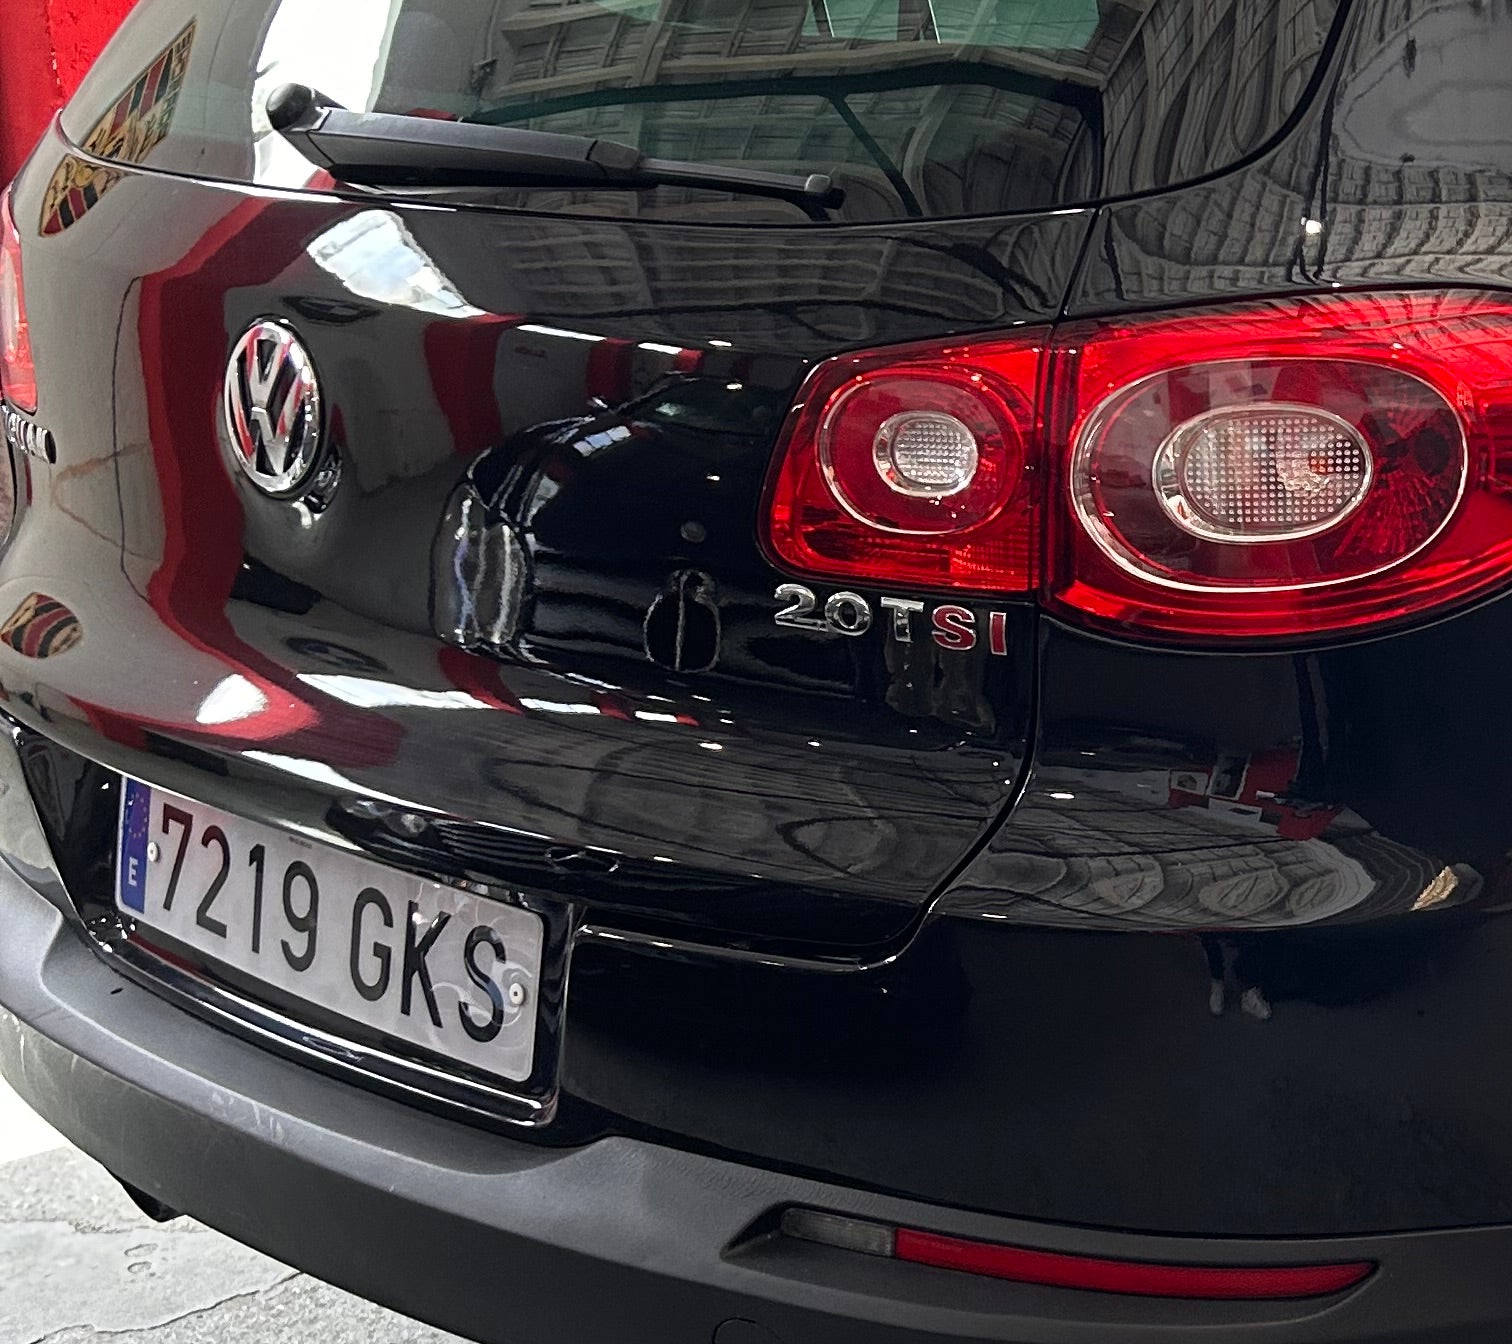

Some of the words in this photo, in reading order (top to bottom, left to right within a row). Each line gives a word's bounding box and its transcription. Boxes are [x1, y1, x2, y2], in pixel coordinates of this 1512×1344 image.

[127, 855, 138, 888] E
[162, 802, 320, 973] 7219
[350, 887, 507, 1043] GKS
